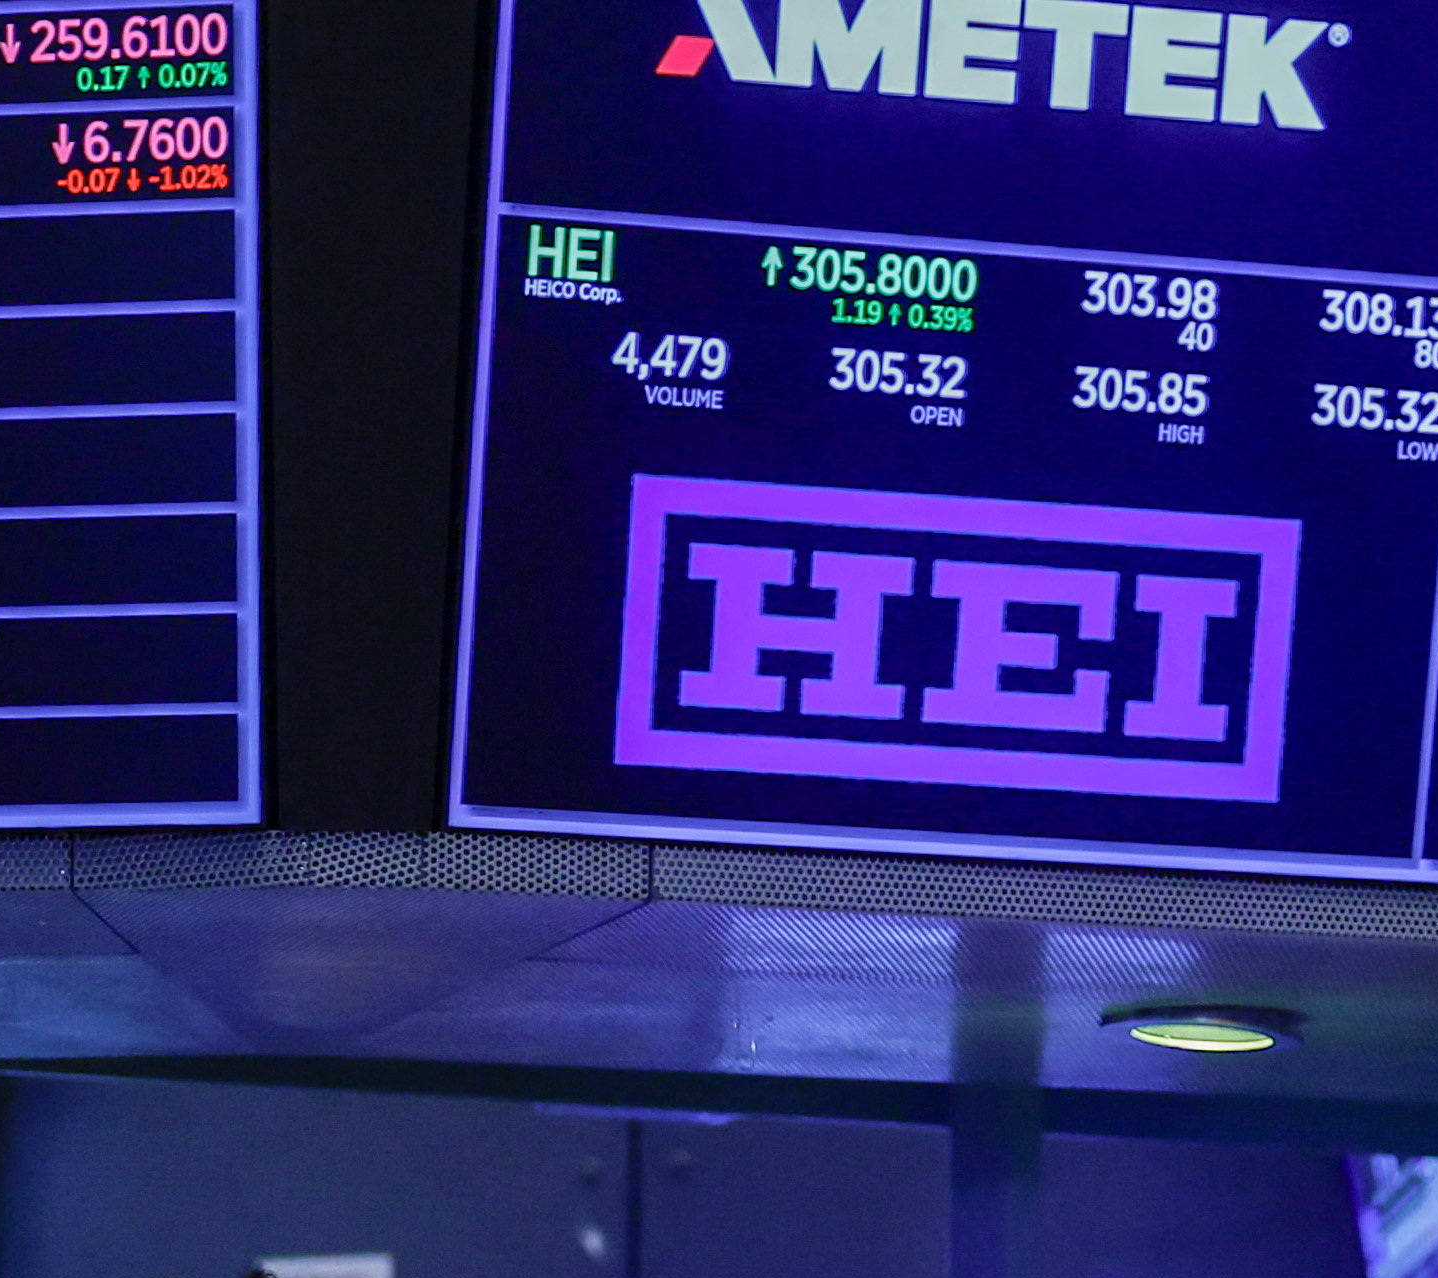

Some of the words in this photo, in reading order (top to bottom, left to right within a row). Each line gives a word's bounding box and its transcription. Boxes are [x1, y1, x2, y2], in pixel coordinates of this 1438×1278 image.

[29, 12, 228, 64] 259.6100
[656, 0, 1331, 131] AMETEK
[83, 115, 229, 164] 6.7600
[527, 224, 615, 283] HEI
[789, 245, 978, 303] 305.8000
[524, 277, 576, 300] HEICO
[578, 282, 622, 306] Corp.
[831, 297, 884, 326] 1.19
[907, 303, 974, 333] 0.39%
[1080, 270, 1218, 321] 303.98
[611, 331, 727, 381] 4,479
[1177, 320, 1215, 352] 40
[644, 384, 725, 410] VOLUME
[828, 347, 966, 400] 305.32
[1072, 365, 1208, 417] 305.85
[909, 404, 963, 428] OPEN
[1157, 422, 1205, 445] HIGH
[677, 541, 1241, 743] HEI
